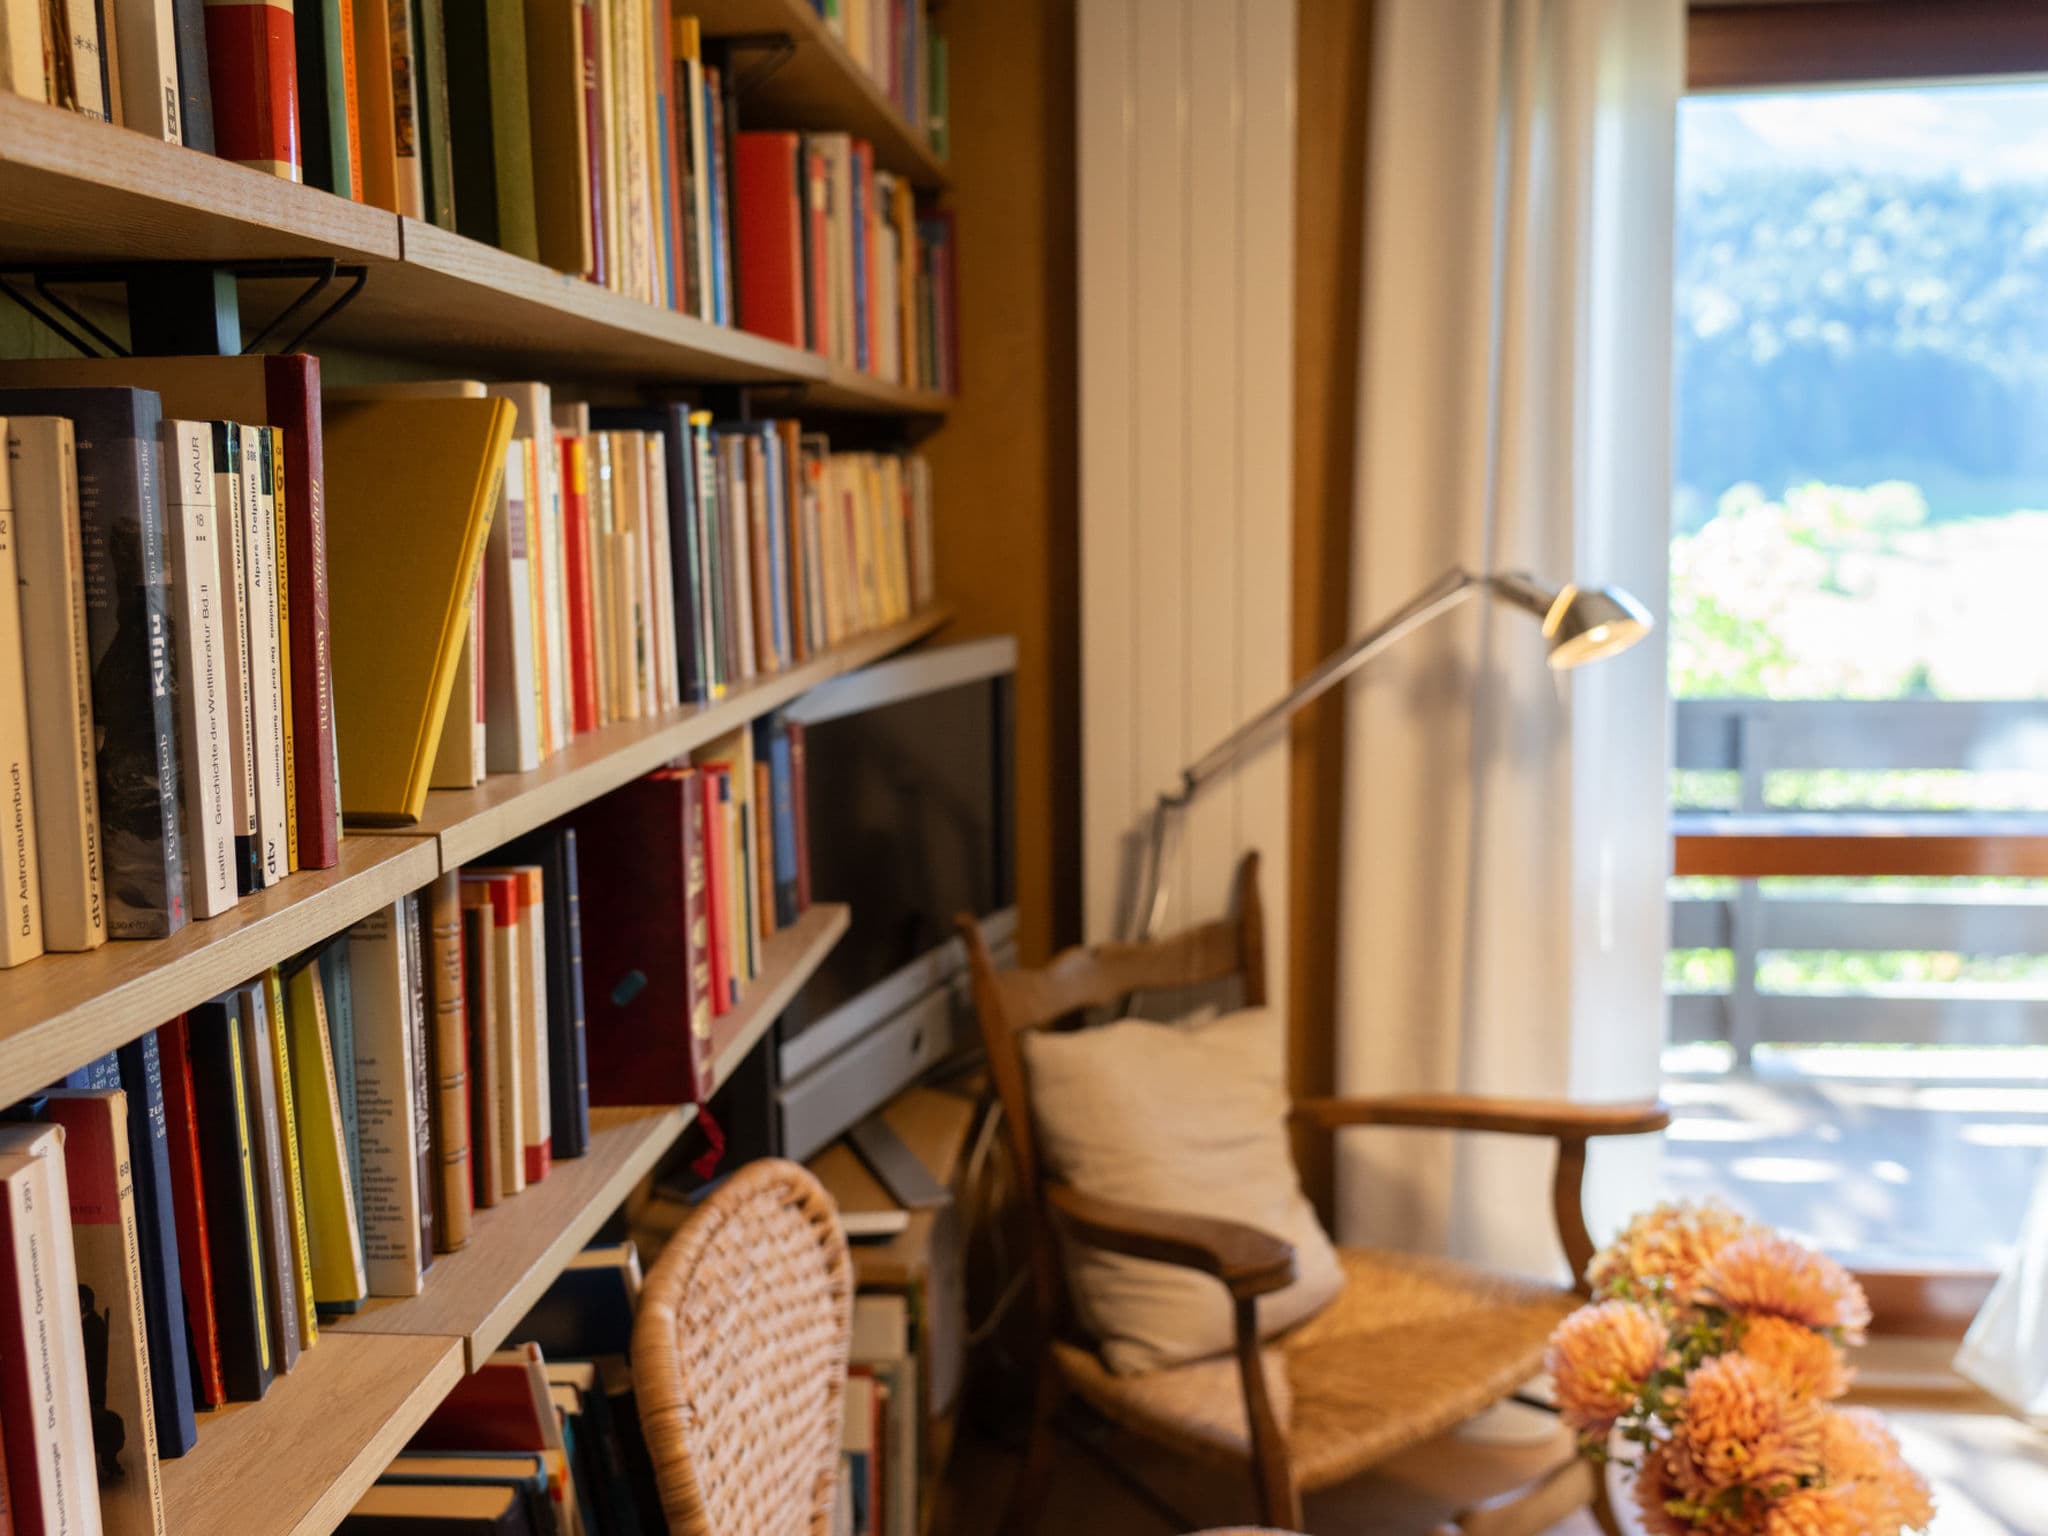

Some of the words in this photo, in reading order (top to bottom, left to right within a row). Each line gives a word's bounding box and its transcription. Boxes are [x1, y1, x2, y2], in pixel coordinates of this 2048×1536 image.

[191, 436, 202, 495] KNAUR
[232, 478, 242, 570] HOFMANNSTHAL
[250, 473, 259, 534] Delphine
[152, 613, 166, 697] Kilju
[202, 624, 216, 714] Weltliteratur
[318, 630, 328, 733] TUCHOLSKY
[210, 715, 219, 741] der
[210, 743, 223, 825] Geschichte
[10, 762, 29, 900] Astronautenbuch
[166, 811, 177, 861] Peter
[216, 836, 227, 890] Laaths:
[267, 841, 277, 875] dtv
[87, 822, 101, 928] dtv-Atlas
[21, 904, 31, 937] Das
[29, 1233, 45, 1316] Oppermann
[127, 1216, 137, 1264] Hunden
[132, 1265, 145, 1343] neurotischen
[139, 1346, 149, 1364] mit
